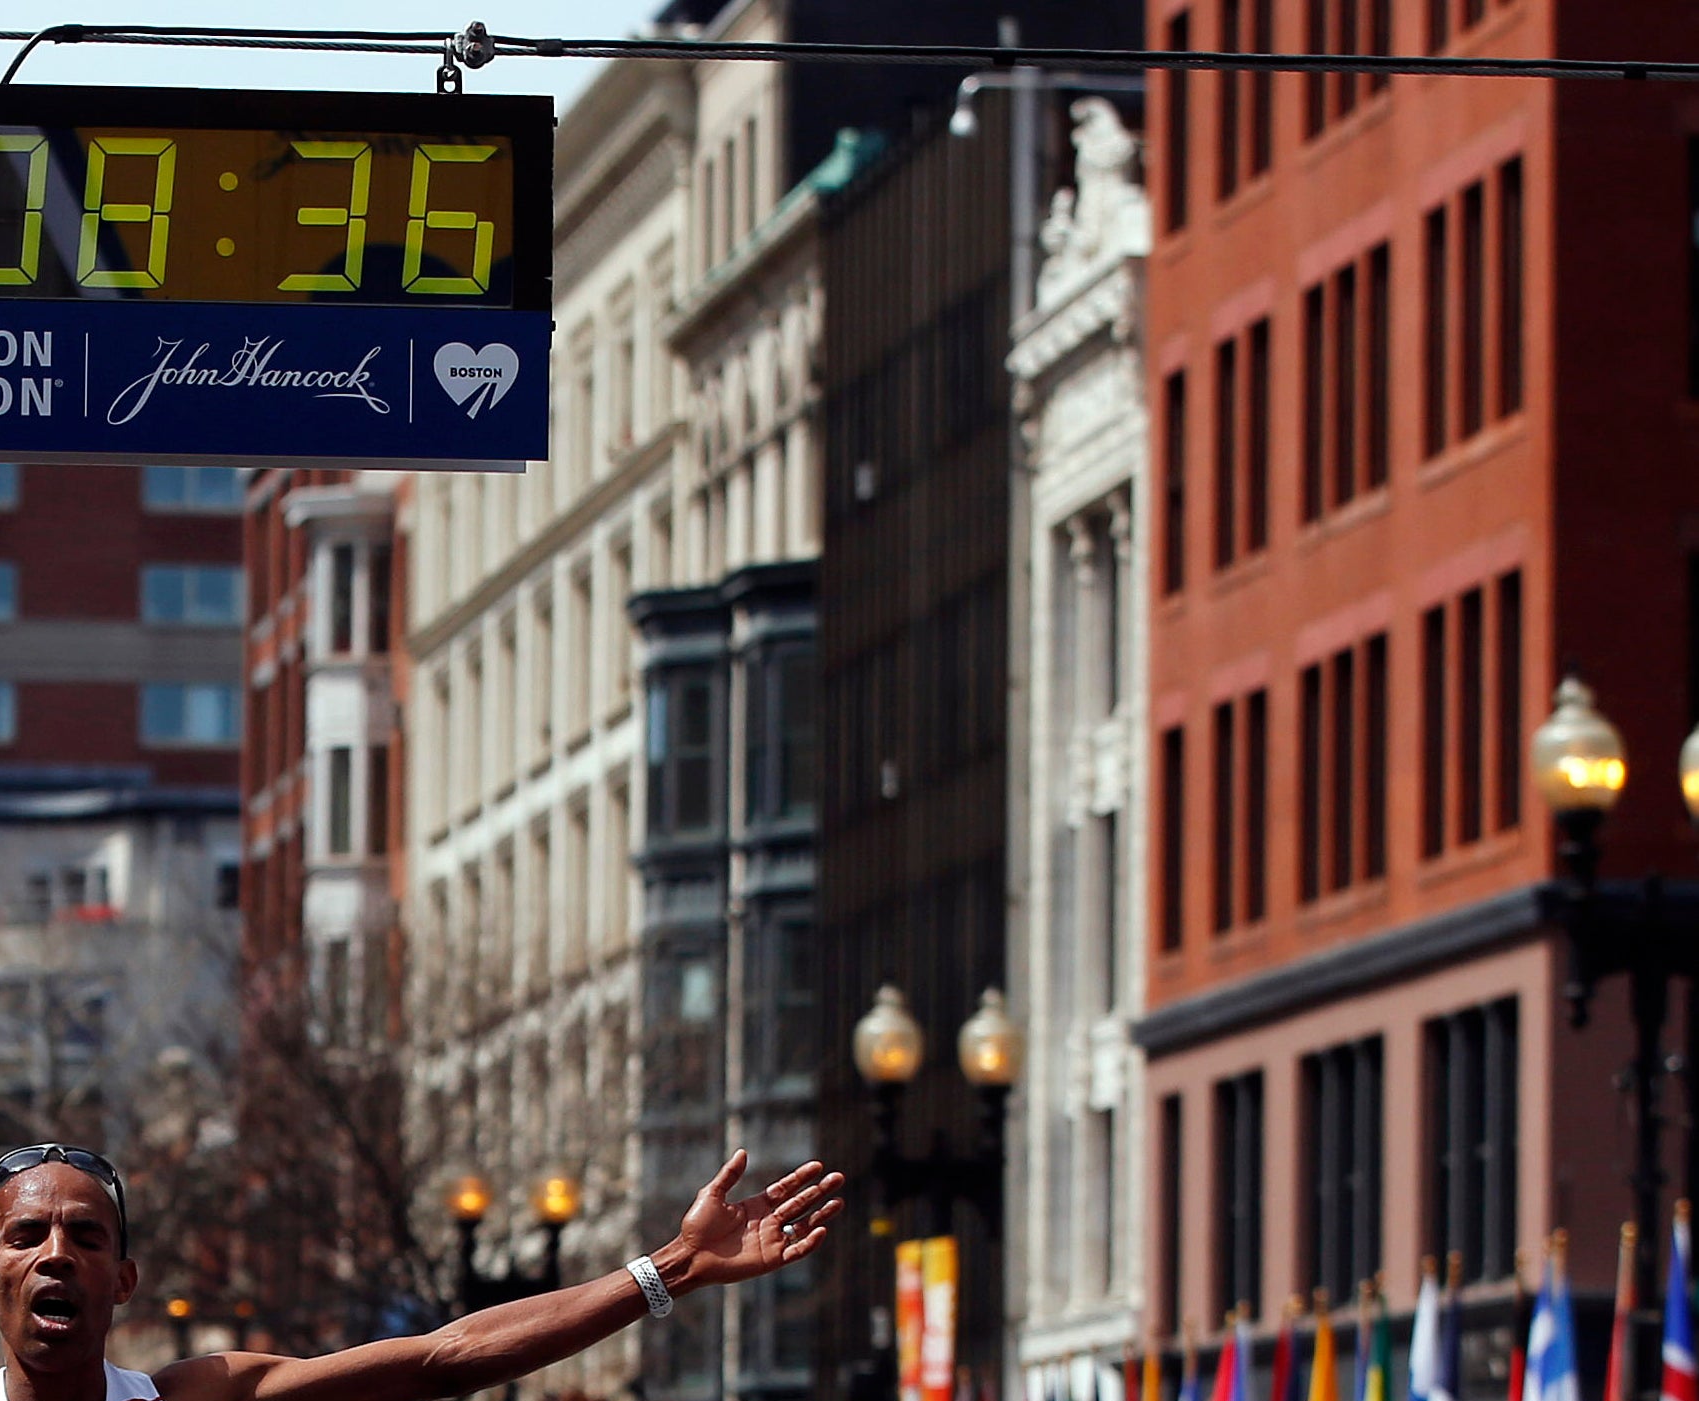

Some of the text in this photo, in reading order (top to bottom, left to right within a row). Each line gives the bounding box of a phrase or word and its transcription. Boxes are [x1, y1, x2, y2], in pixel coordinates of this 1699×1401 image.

[107, 335, 390, 425] John Hancock
[450, 366, 502, 379] BOSTON
